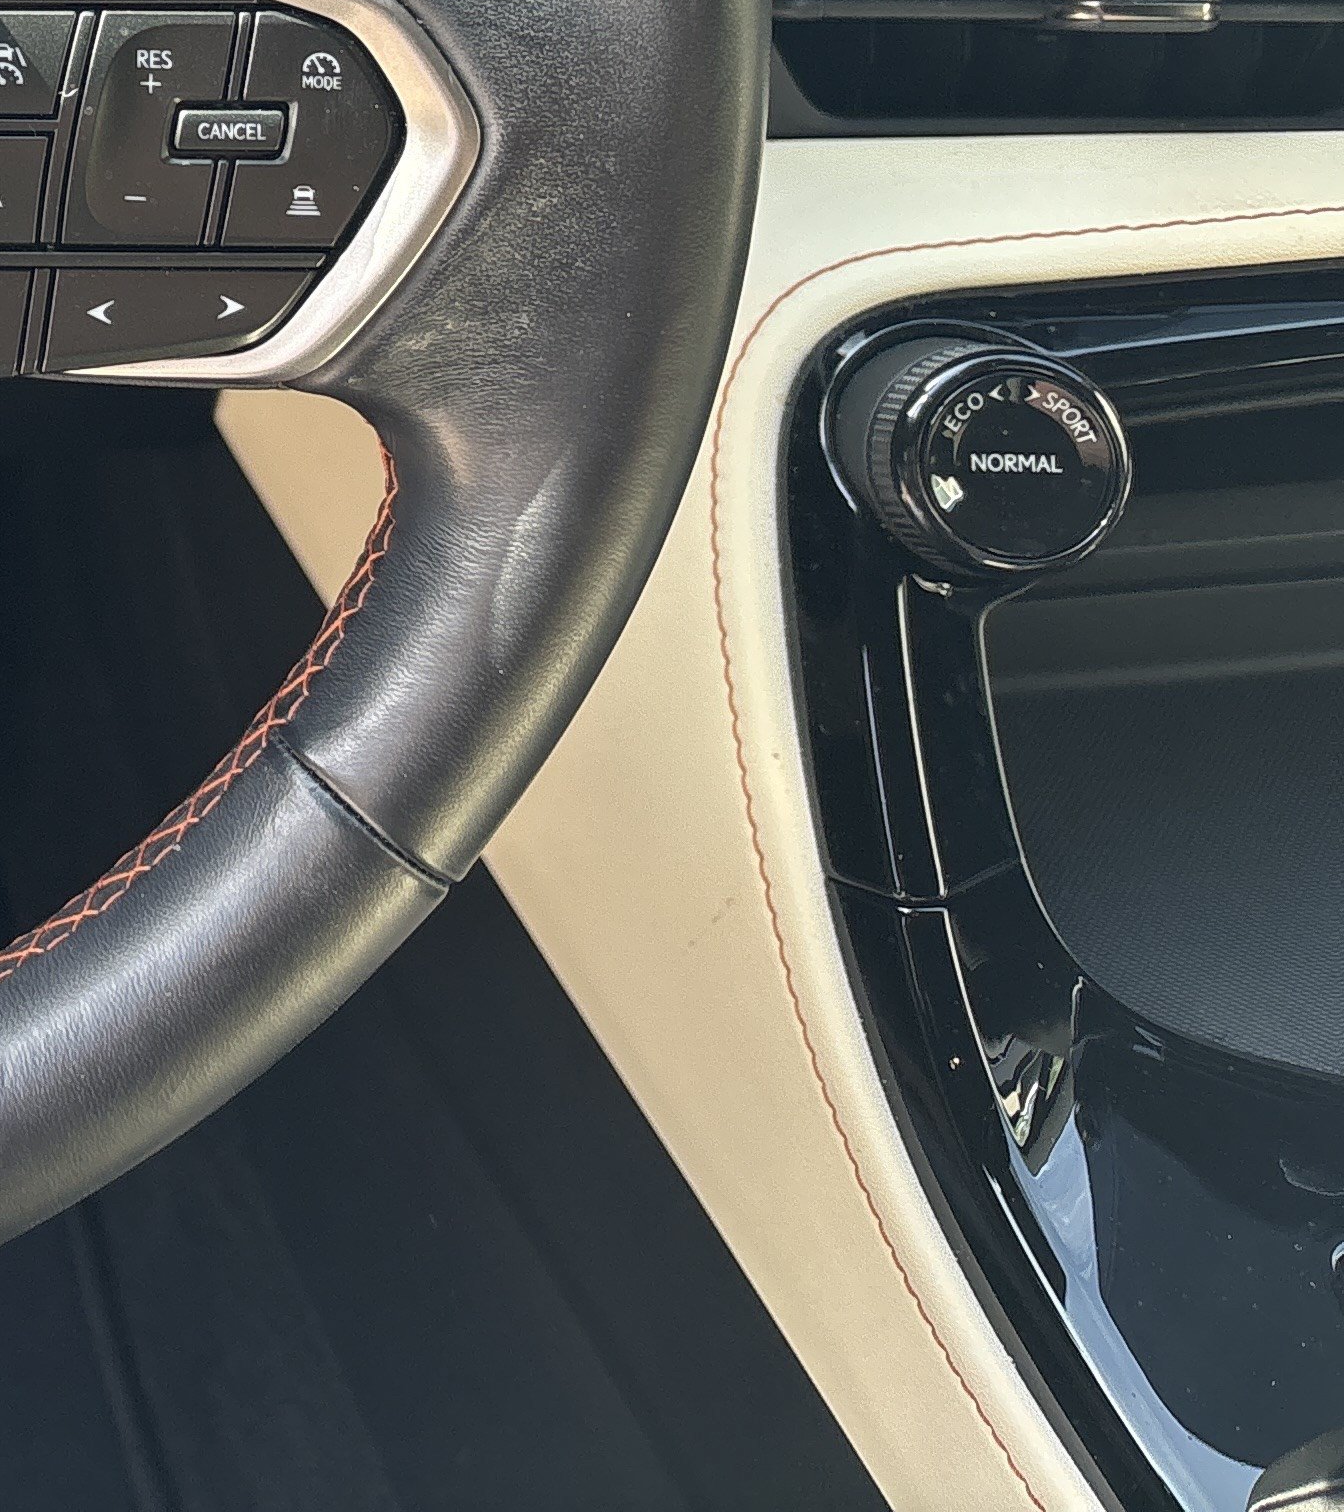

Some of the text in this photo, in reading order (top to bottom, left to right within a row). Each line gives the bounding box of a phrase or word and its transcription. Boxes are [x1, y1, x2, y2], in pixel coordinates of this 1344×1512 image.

[136, 50, 172, 70] RES
[301, 75, 342, 91] MODE
[197, 121, 267, 142] CANCEL
[943, 392, 984, 433] ECO
[1042, 392, 1097, 444] SPORT
[970, 453, 1063, 474] NORMAL
